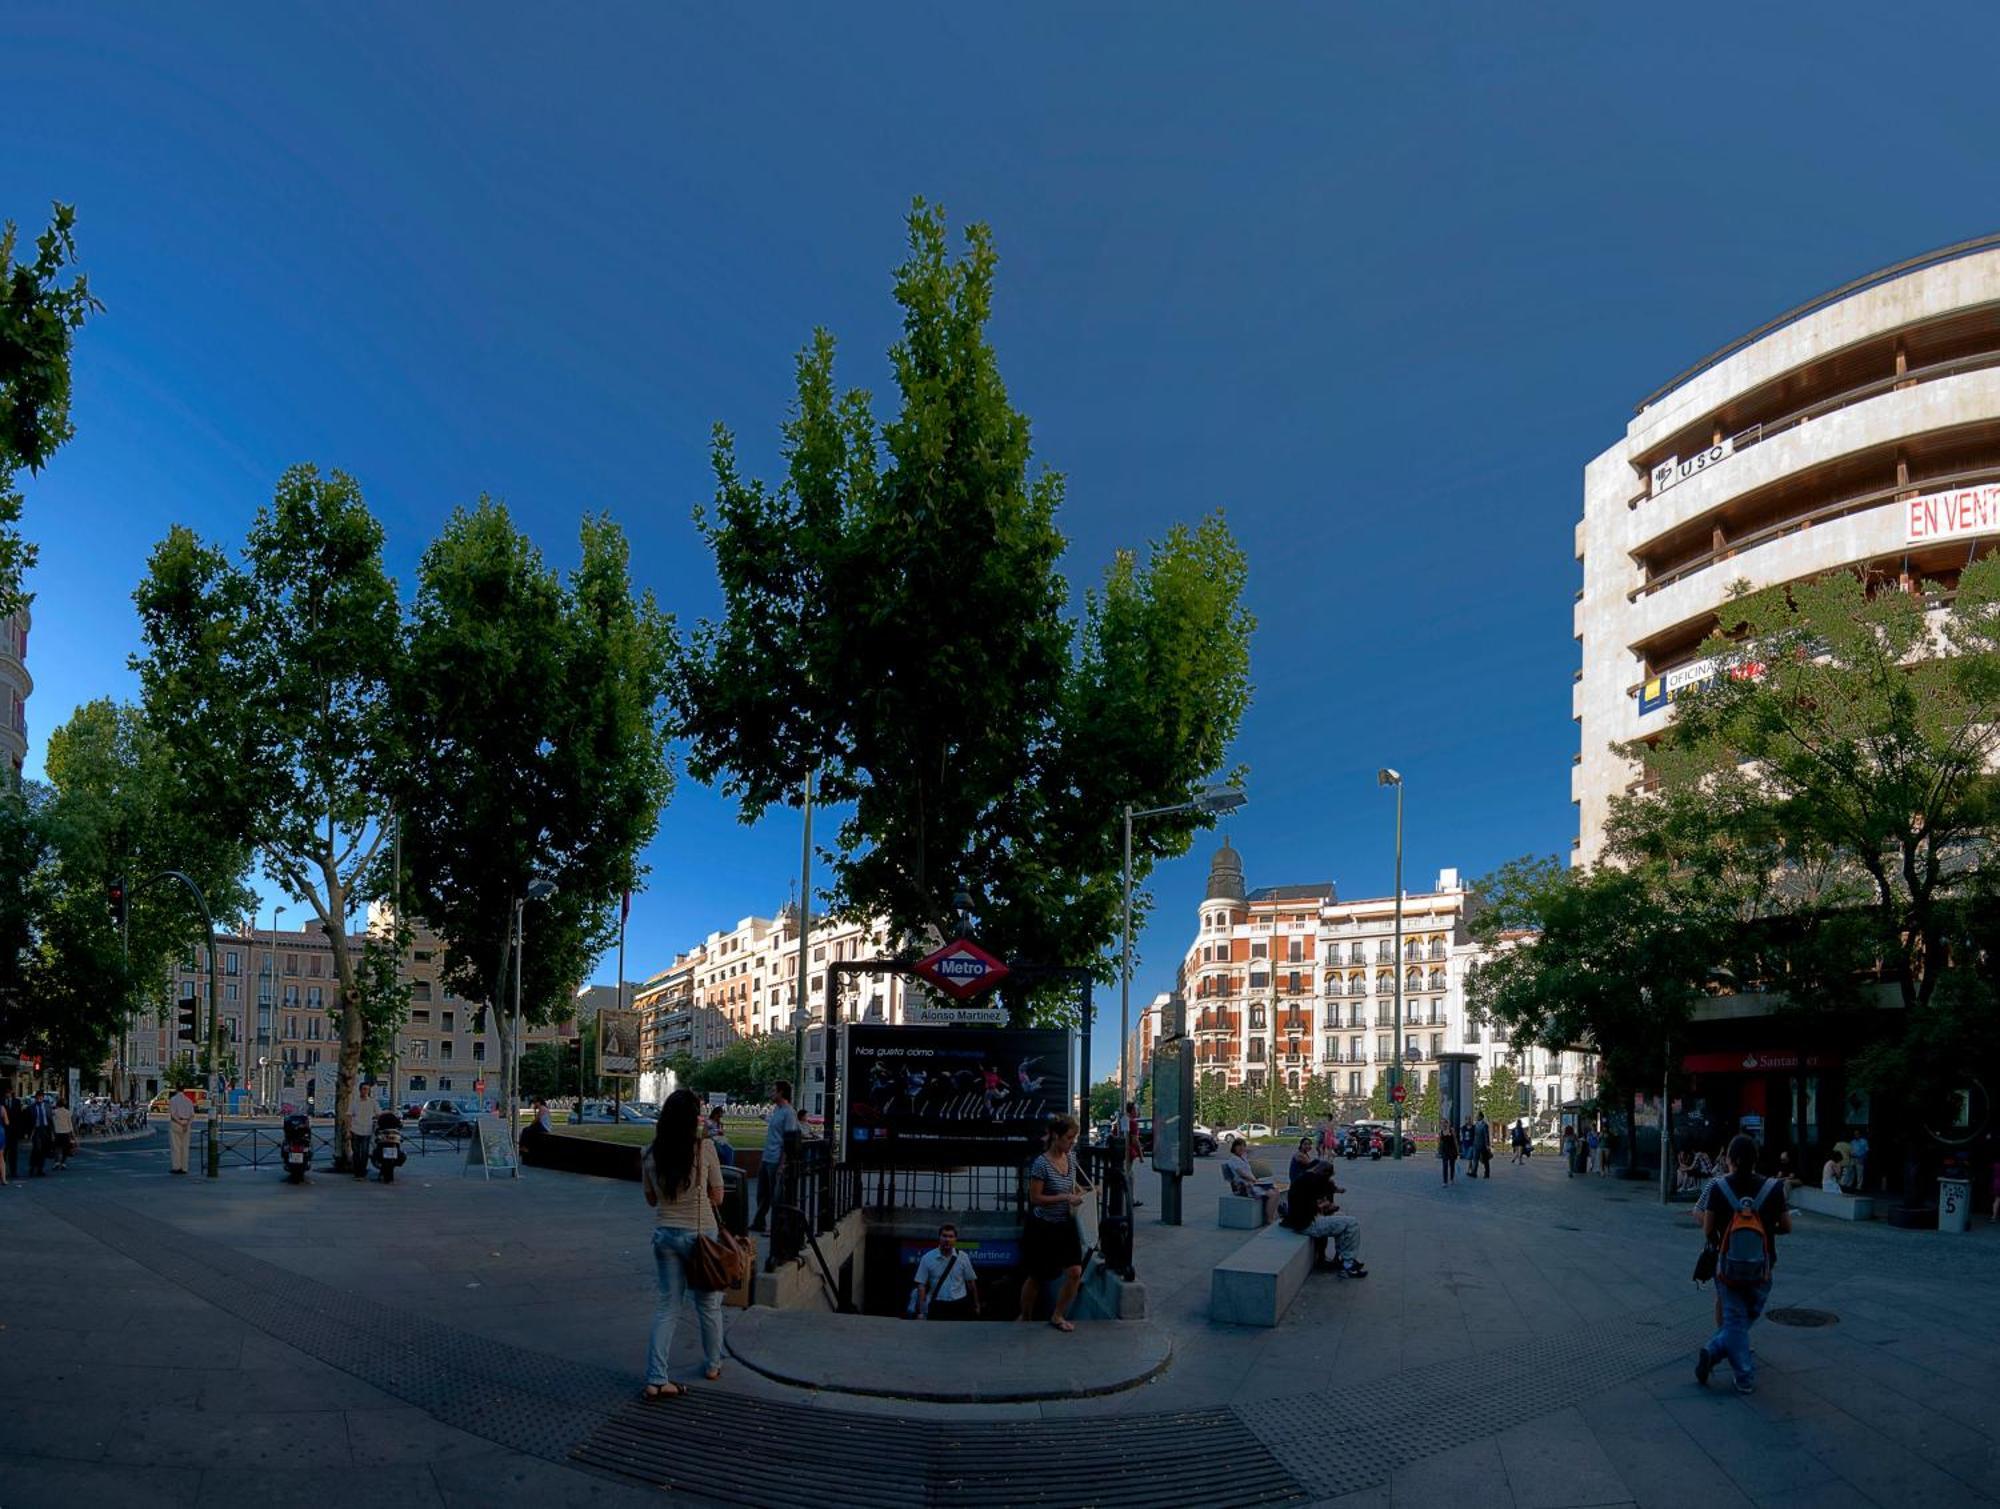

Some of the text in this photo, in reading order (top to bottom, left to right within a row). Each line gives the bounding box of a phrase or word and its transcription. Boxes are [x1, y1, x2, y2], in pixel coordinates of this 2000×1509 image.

[1681, 445, 1723, 477] USO
[1910, 498, 1938, 537] EN
[941, 960, 983, 974] Metro
[921, 1010, 954, 1021] Alonso
[855, 1046, 874, 1056] Nos
[876, 1047, 904, 1058] gusta
